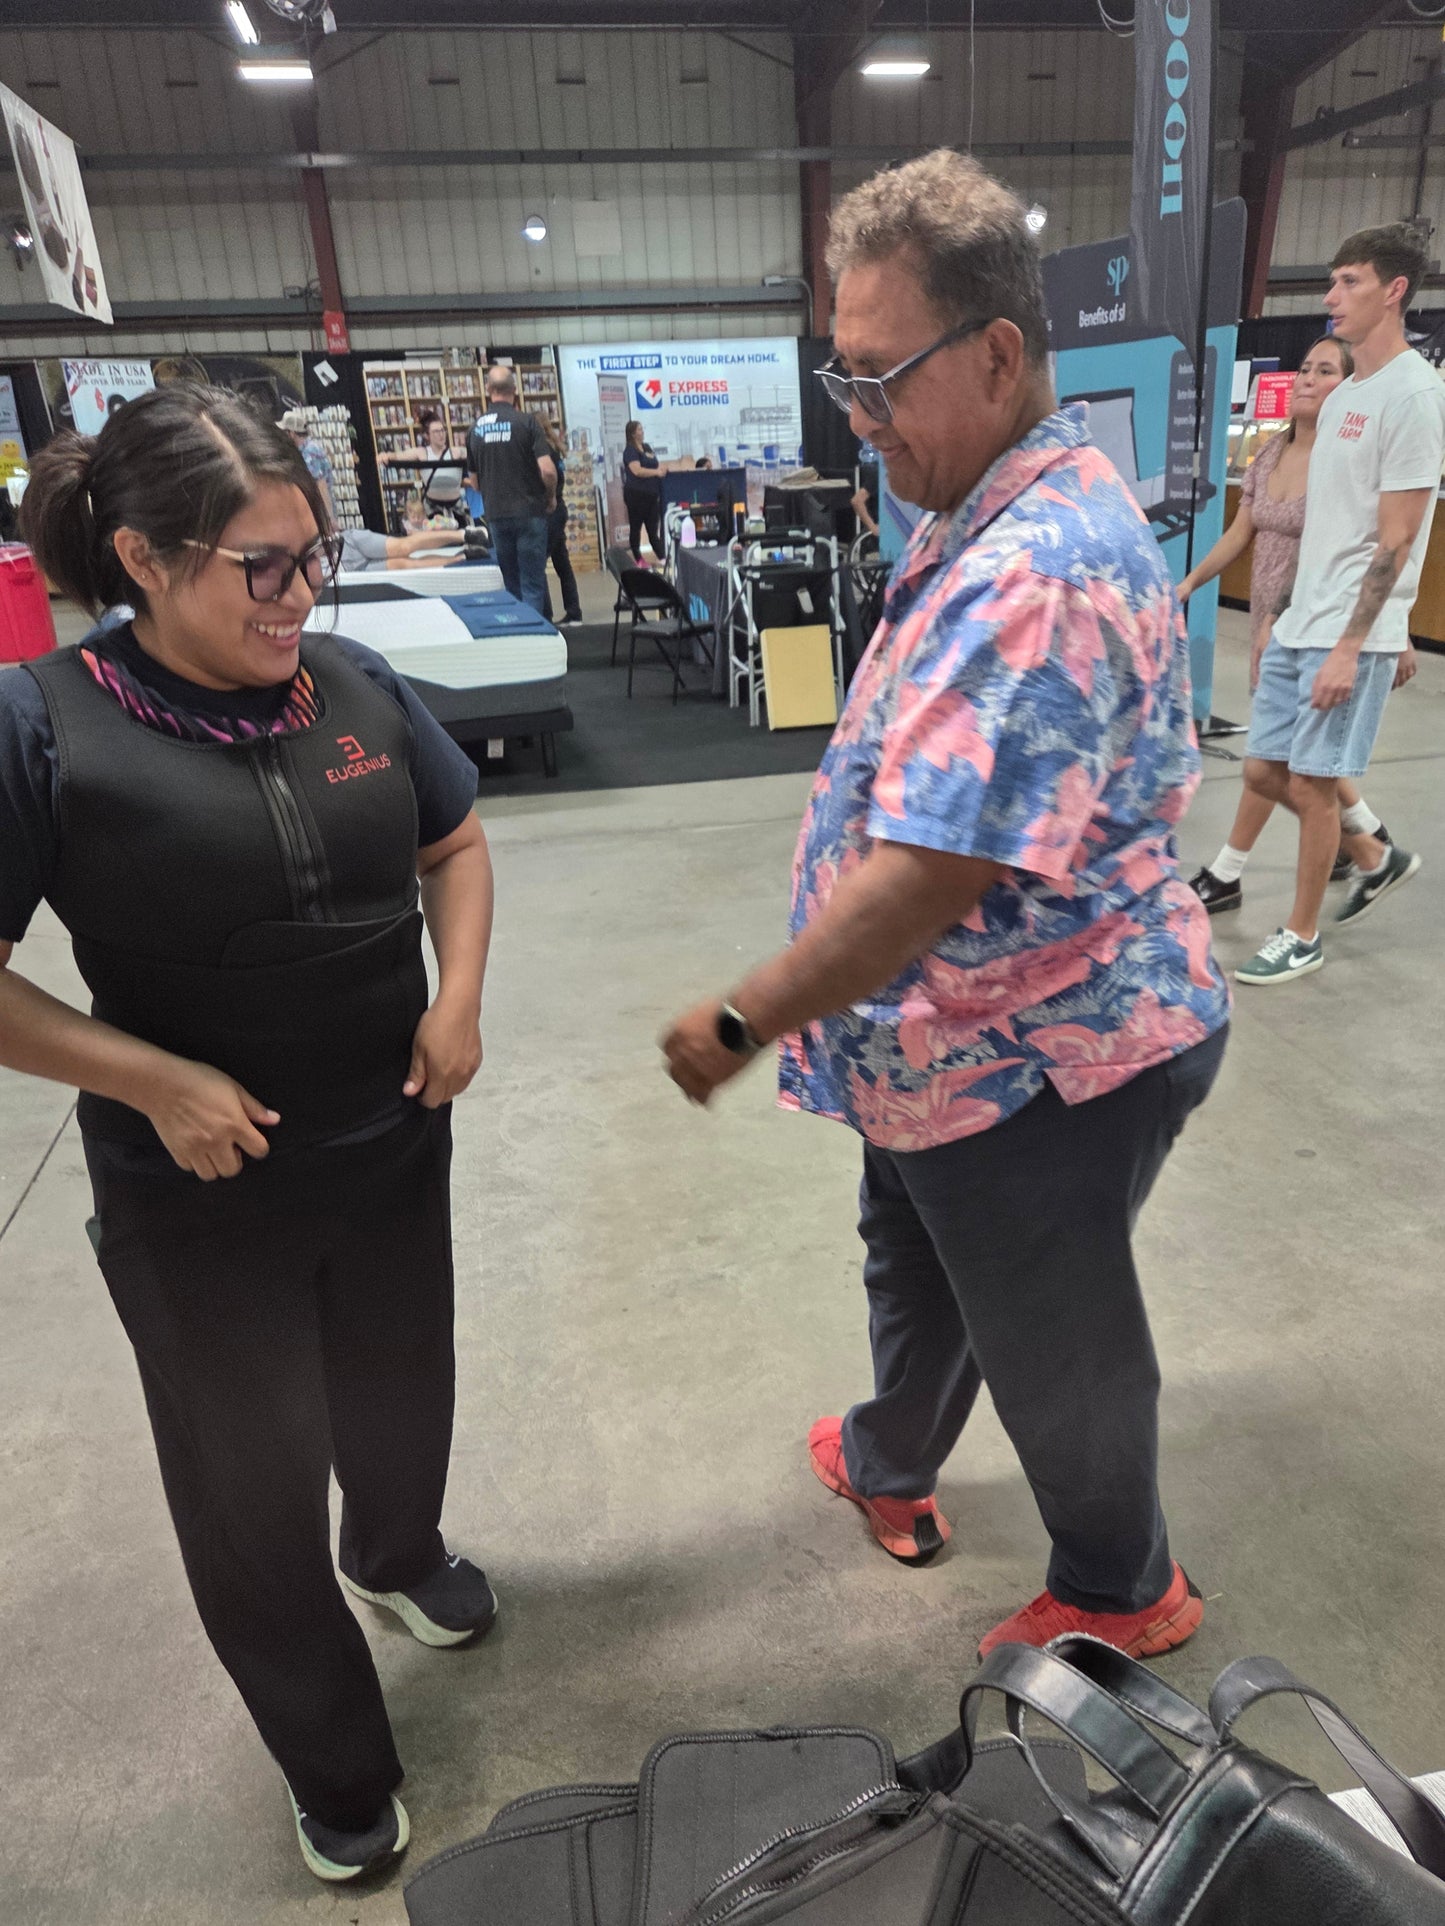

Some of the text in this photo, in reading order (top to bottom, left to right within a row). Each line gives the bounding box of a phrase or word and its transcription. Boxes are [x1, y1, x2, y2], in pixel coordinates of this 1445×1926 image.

[1079, 305, 1108, 328] Benefits
[1109, 303, 1119, 323] of
[577, 353, 779, 370] THE FIRST STEP TO YOUR DREAM HOME.
[70, 363, 147, 377] MADE IN USA
[111, 376, 125, 386] 100
[126, 378, 147, 386] YEARS
[669, 380, 728, 394] EXPRESS
[670, 394, 729, 407] FLOORING
[1343, 411, 1369, 429] TANK
[1336, 426, 1363, 440] FARM
[325, 753, 391, 784] EUGENIUS
